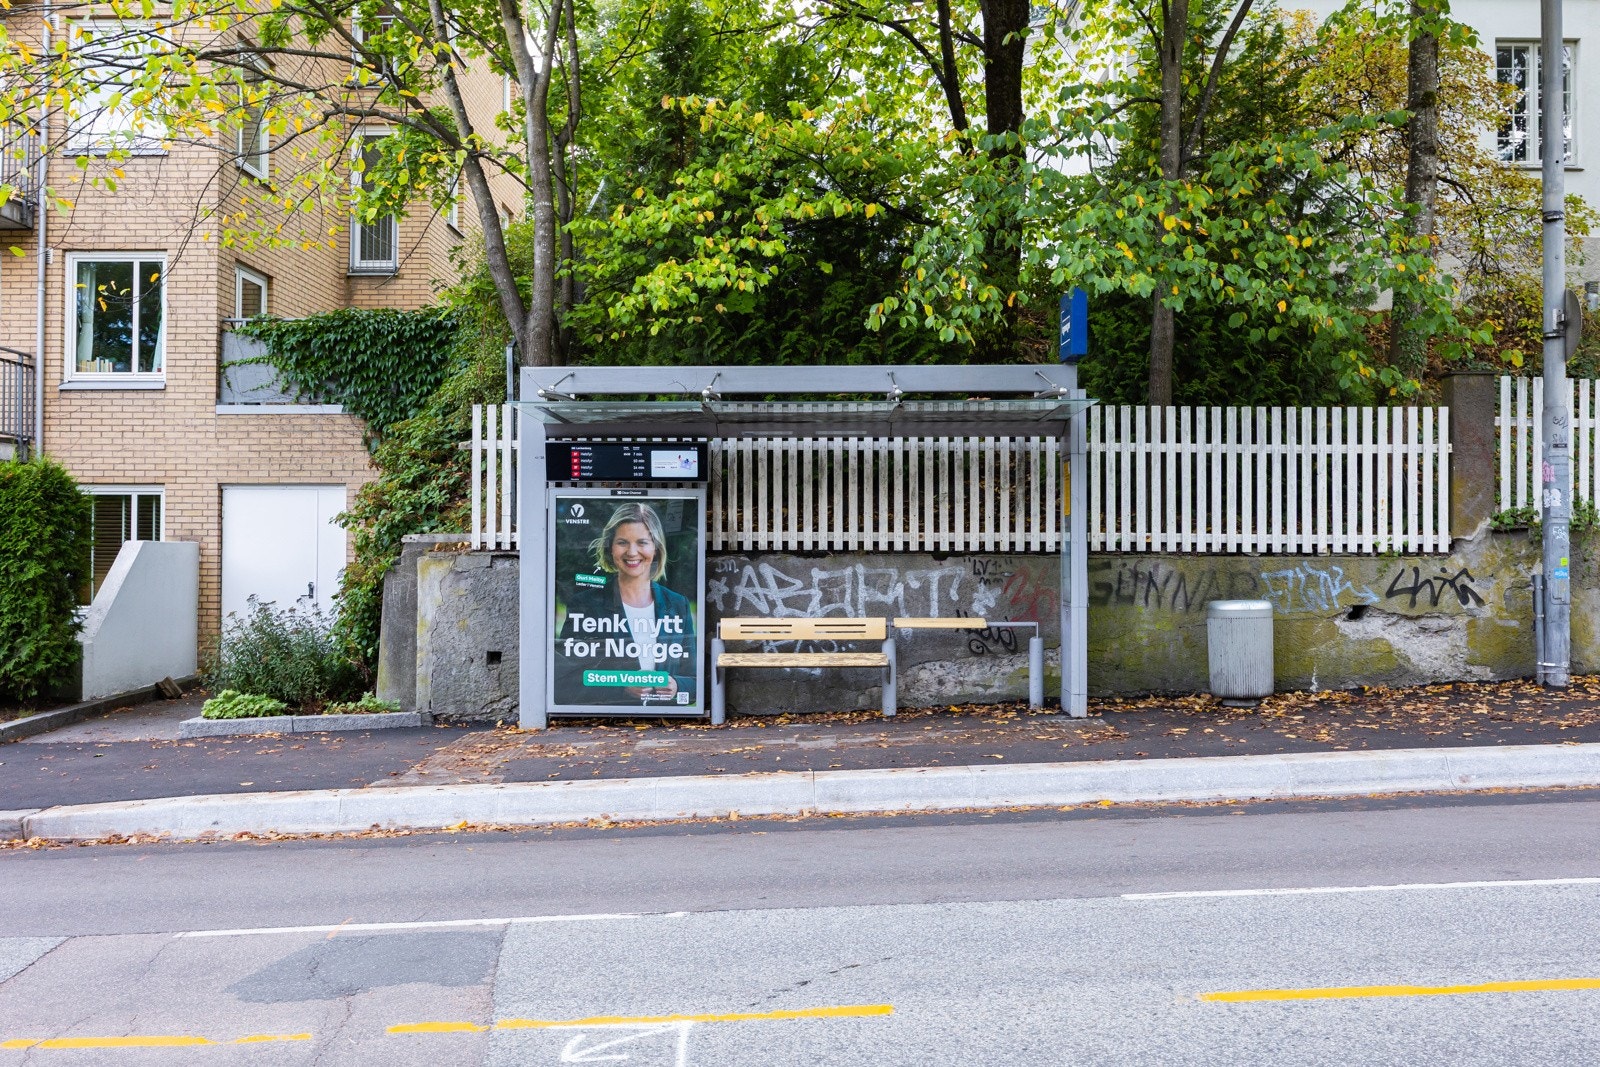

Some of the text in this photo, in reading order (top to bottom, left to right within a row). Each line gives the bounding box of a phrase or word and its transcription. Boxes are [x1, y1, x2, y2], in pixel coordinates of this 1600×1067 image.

[569, 613, 683, 638] Tenk nytt
[564, 638, 689, 663] for Norge.
[587, 673, 664, 684] Stem Venstre
